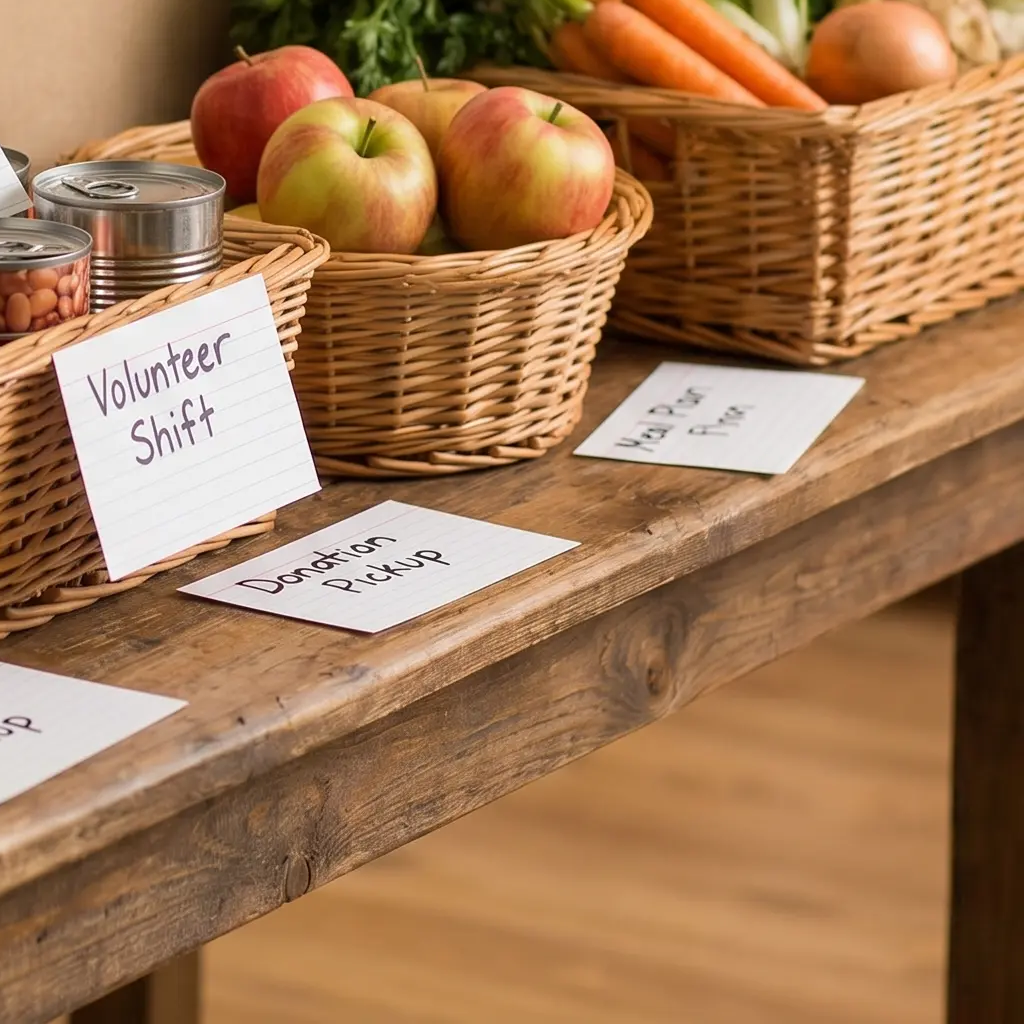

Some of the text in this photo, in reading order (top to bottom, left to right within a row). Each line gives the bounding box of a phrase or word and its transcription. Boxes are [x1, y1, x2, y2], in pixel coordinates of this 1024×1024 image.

[86, 332, 231, 417] Volunteer
[130, 394, 215, 466] Shift
[234, 535, 397, 595] Donation
[321, 548, 451, 594] Pickup
